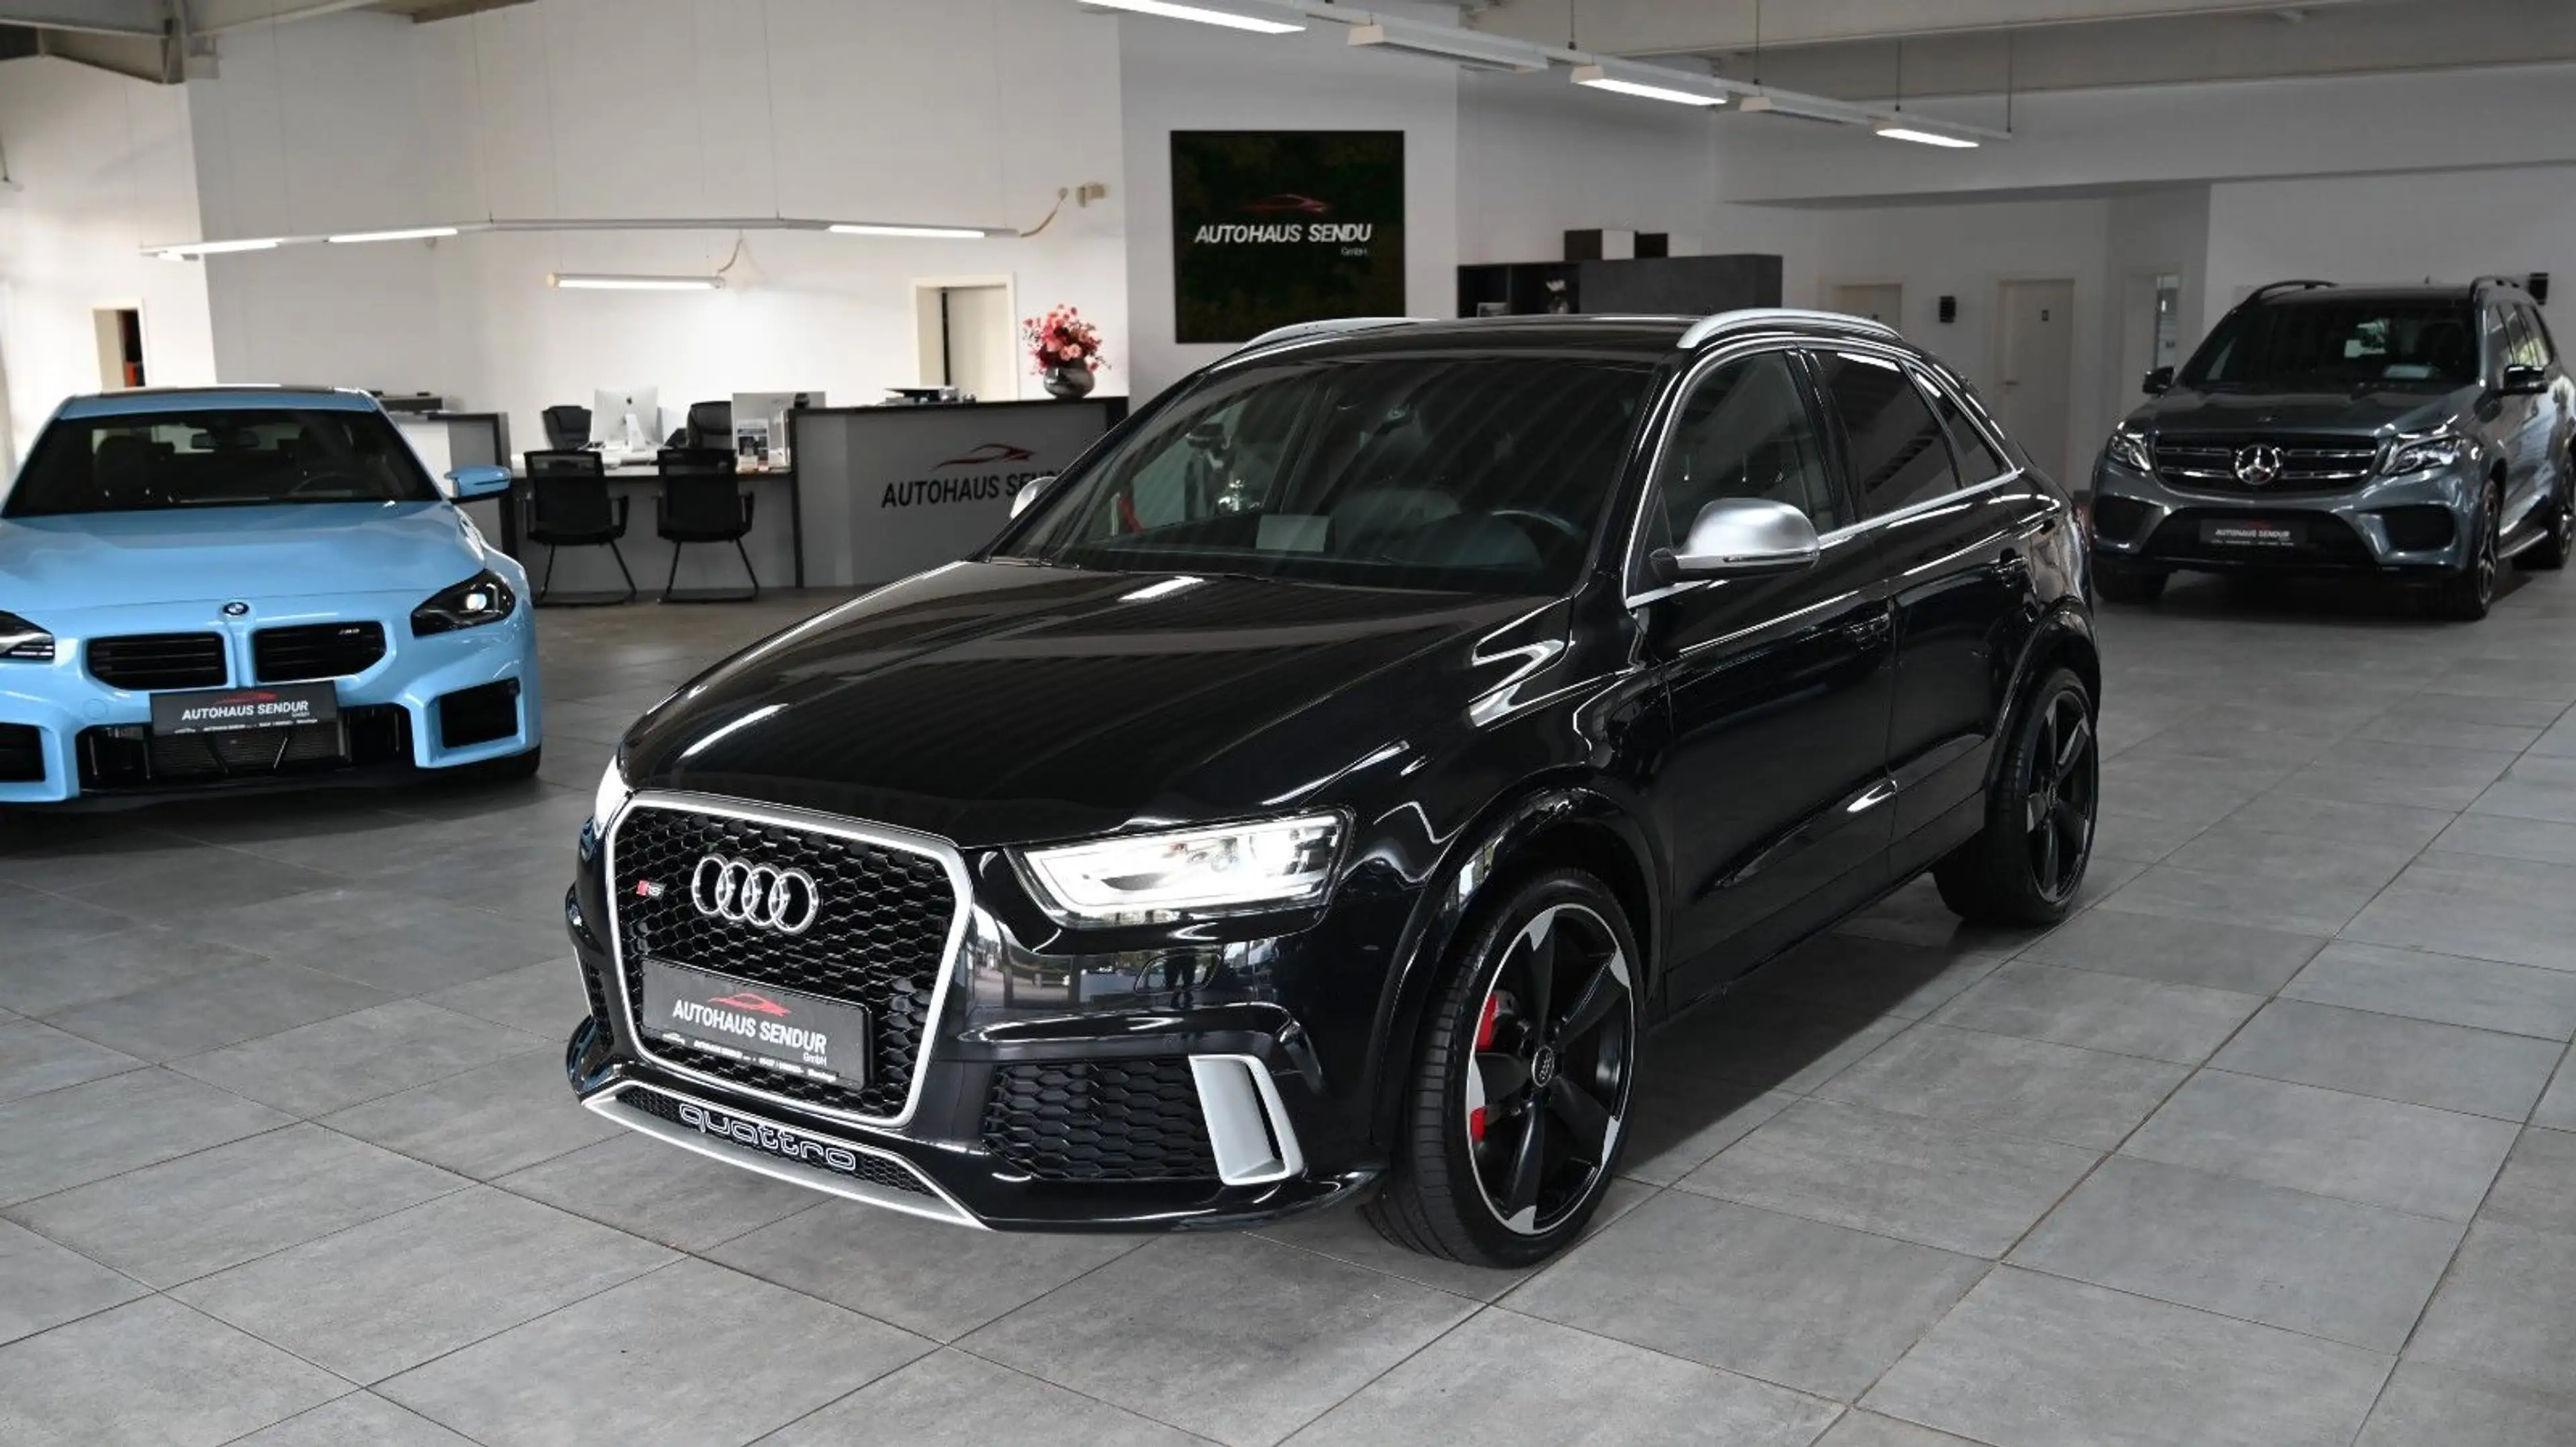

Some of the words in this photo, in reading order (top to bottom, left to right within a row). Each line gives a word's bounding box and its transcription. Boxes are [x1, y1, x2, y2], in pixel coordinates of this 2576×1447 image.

[1195, 224, 1302, 244] AUTOHAUS
[1308, 223, 1372, 242] SENDU
[881, 475, 1000, 508] AUTOHAUS
[181, 704, 254, 721] AUTOHAUS
[258, 700, 309, 715] SENDUR
[672, 1000, 756, 1038] AUTOHAUS
[759, 1020, 827, 1055] SENDUR
[679, 1102, 856, 1171] quattro
